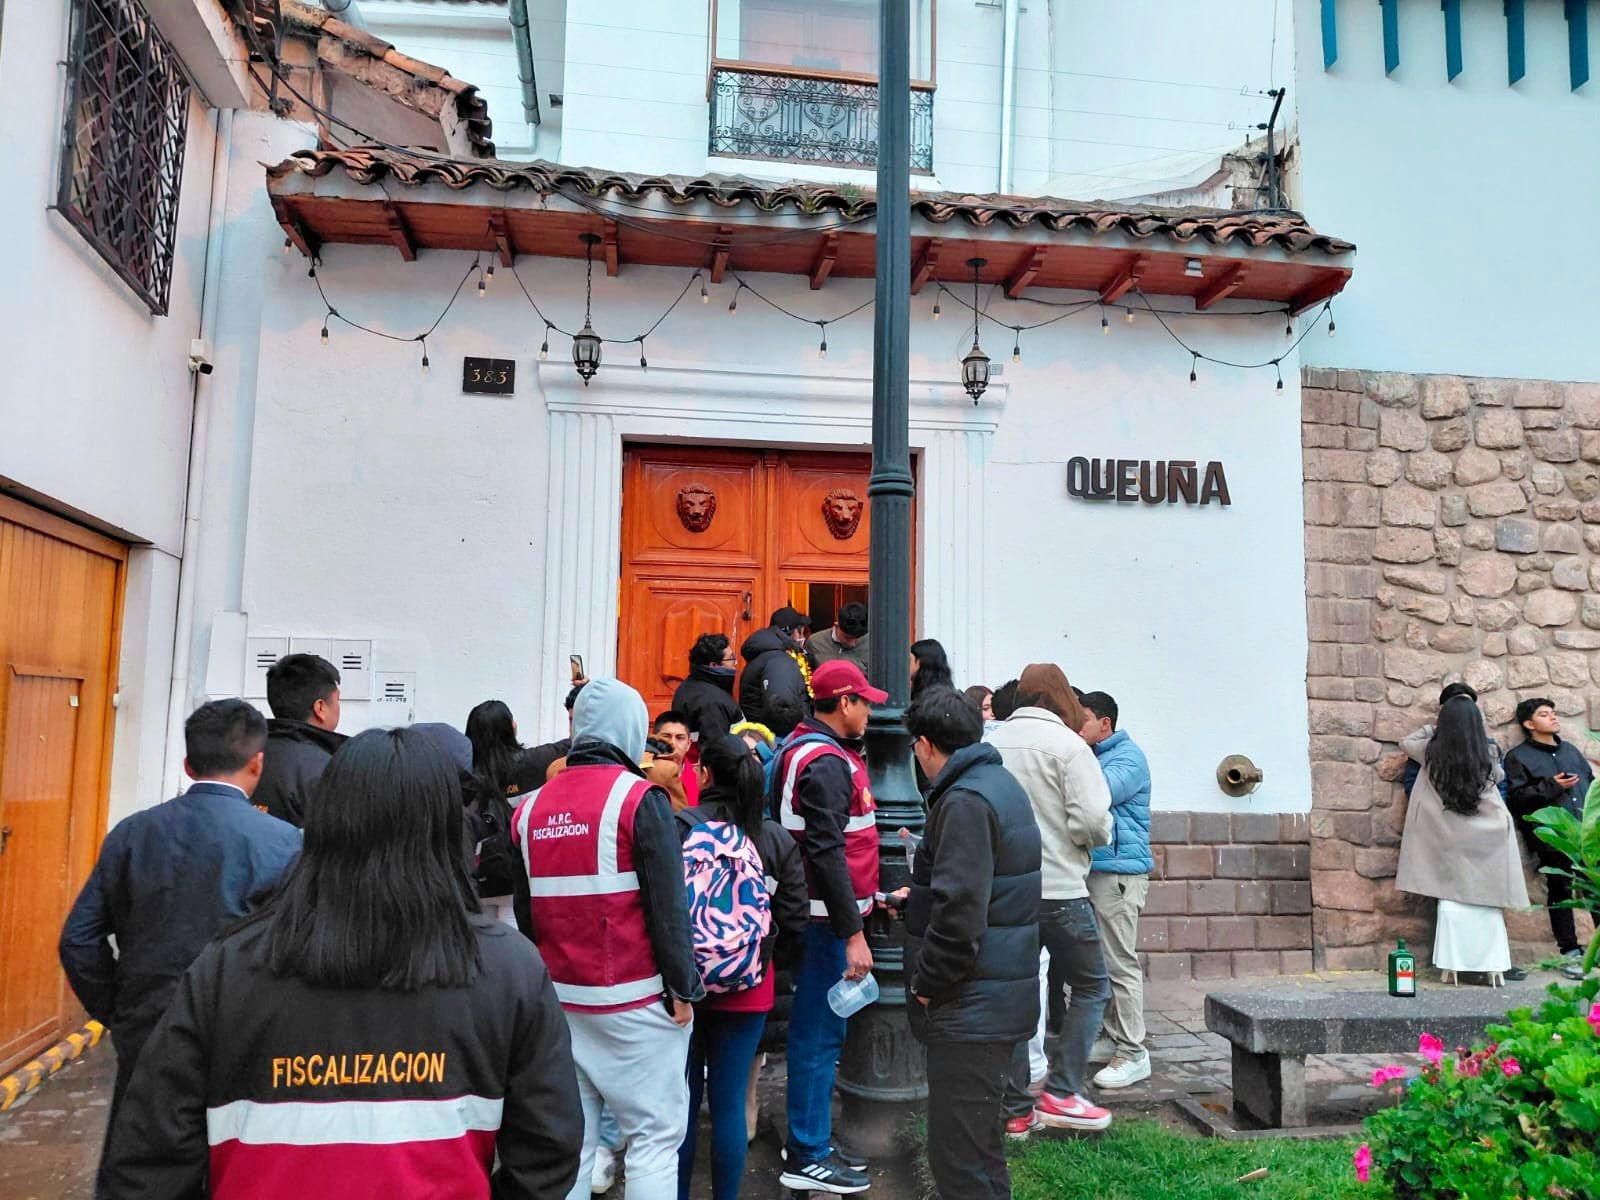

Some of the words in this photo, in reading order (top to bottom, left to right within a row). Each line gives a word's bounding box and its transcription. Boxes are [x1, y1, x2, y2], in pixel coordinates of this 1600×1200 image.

[471, 368, 508, 385] 383
[1066, 456, 1232, 505] QUEUÑA
[532, 823, 589, 841] FISCALIZACION
[272, 1051, 446, 1088] FISCALIZACION
